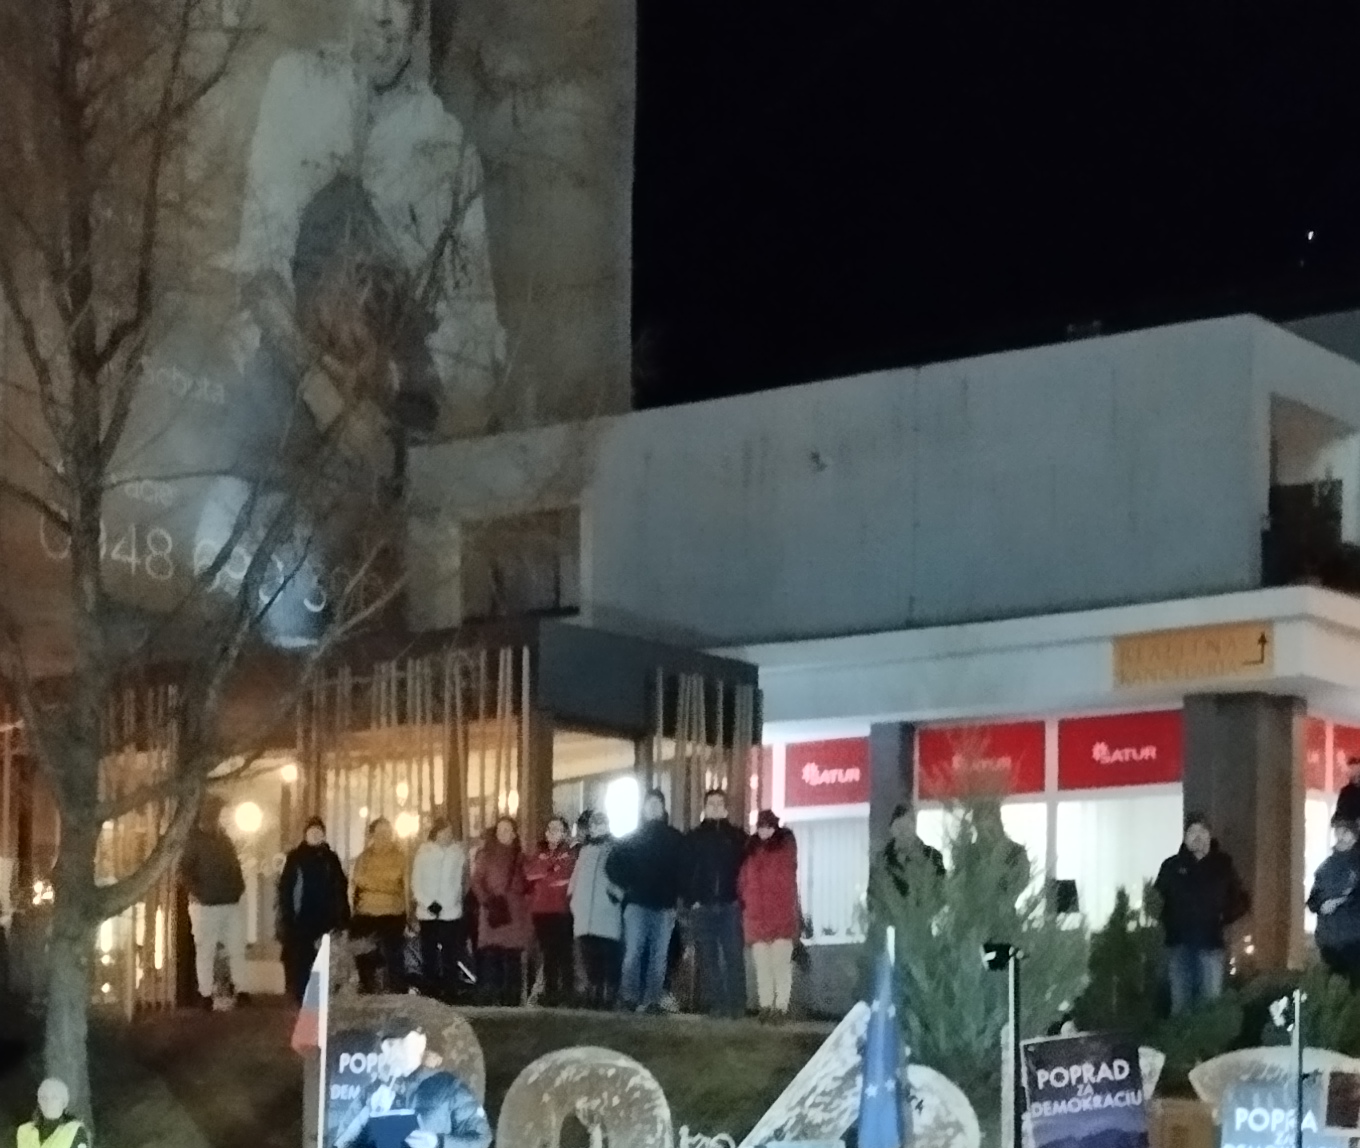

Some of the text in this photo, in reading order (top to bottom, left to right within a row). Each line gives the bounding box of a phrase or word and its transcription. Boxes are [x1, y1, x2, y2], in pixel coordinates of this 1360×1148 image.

[1035, 1057, 1130, 1091] POPRAD
[1030, 1089, 1143, 1118] DEMOKRACIU
[1233, 1106, 1319, 1134] POPRA
